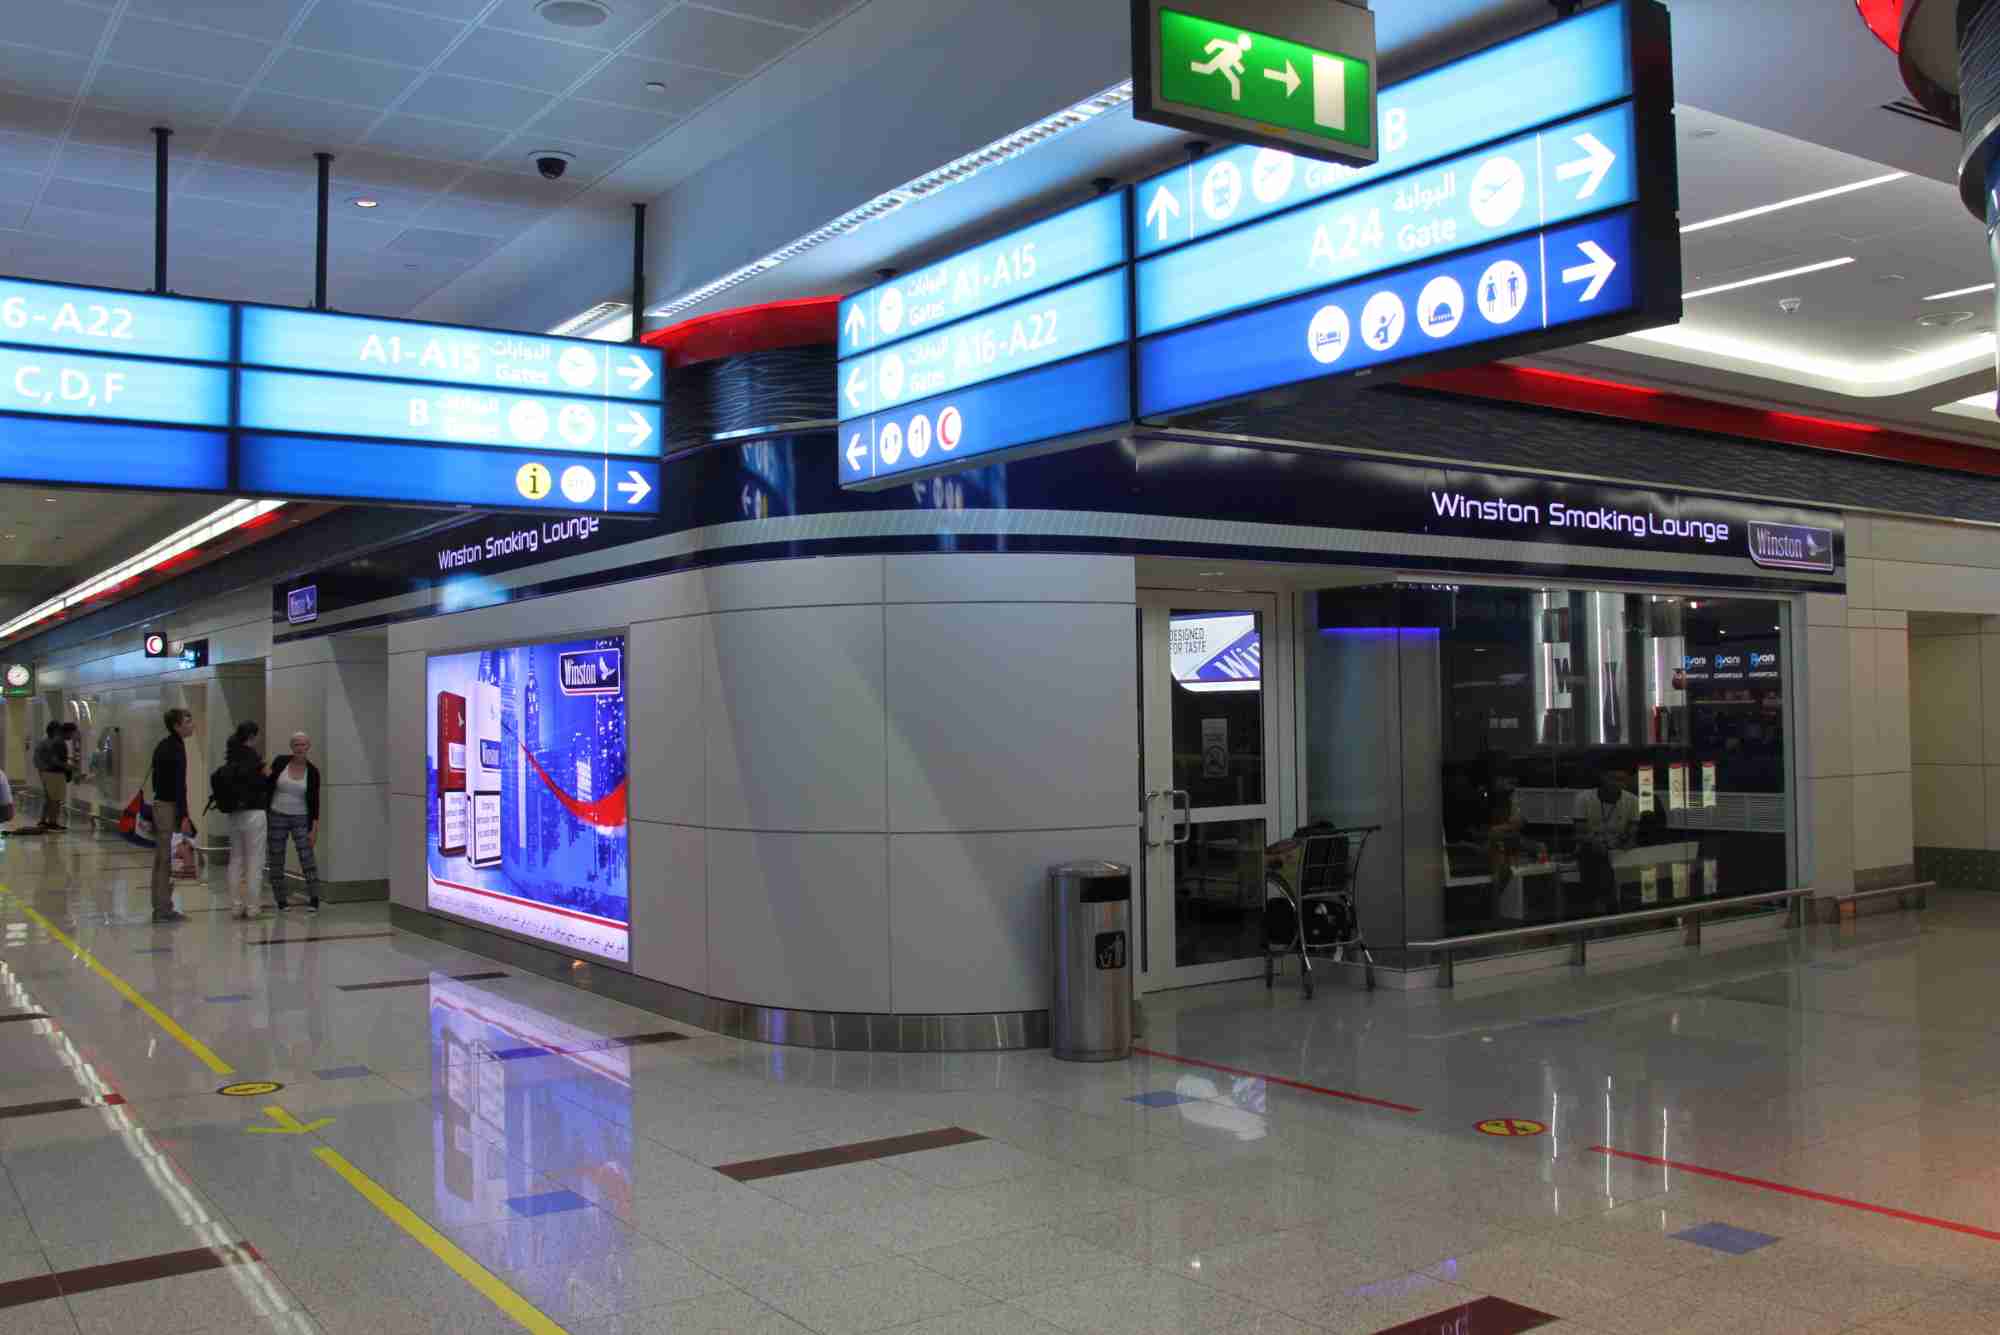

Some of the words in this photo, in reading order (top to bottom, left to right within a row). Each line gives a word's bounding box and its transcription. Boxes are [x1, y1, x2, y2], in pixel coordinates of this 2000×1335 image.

[1384, 107, 1409, 152] B
[1307, 208, 1384, 271] A24
[1398, 217, 1457, 252] Gate
[950, 242, 1037, 305] A1-A15
[359, 334, 481, 374] A1-A15
[953, 308, 1058, 370] A16-A22
[15, 366, 129, 408] C,D,F
[408, 399, 430, 427] B
[1431, 491, 1540, 524] Winston
[1549, 502, 1646, 537] Smoking
[1648, 516, 1730, 543] Lounge
[438, 544, 482, 570] Winston
[485, 529, 538, 552] Smoking
[542, 516, 600, 544] Lounge
[1756, 526, 1803, 560] Winston
[1168, 627, 1205, 642] DESIGNED
[1184, 640, 1207, 655] TASTE
[564, 658, 597, 686] Winston
